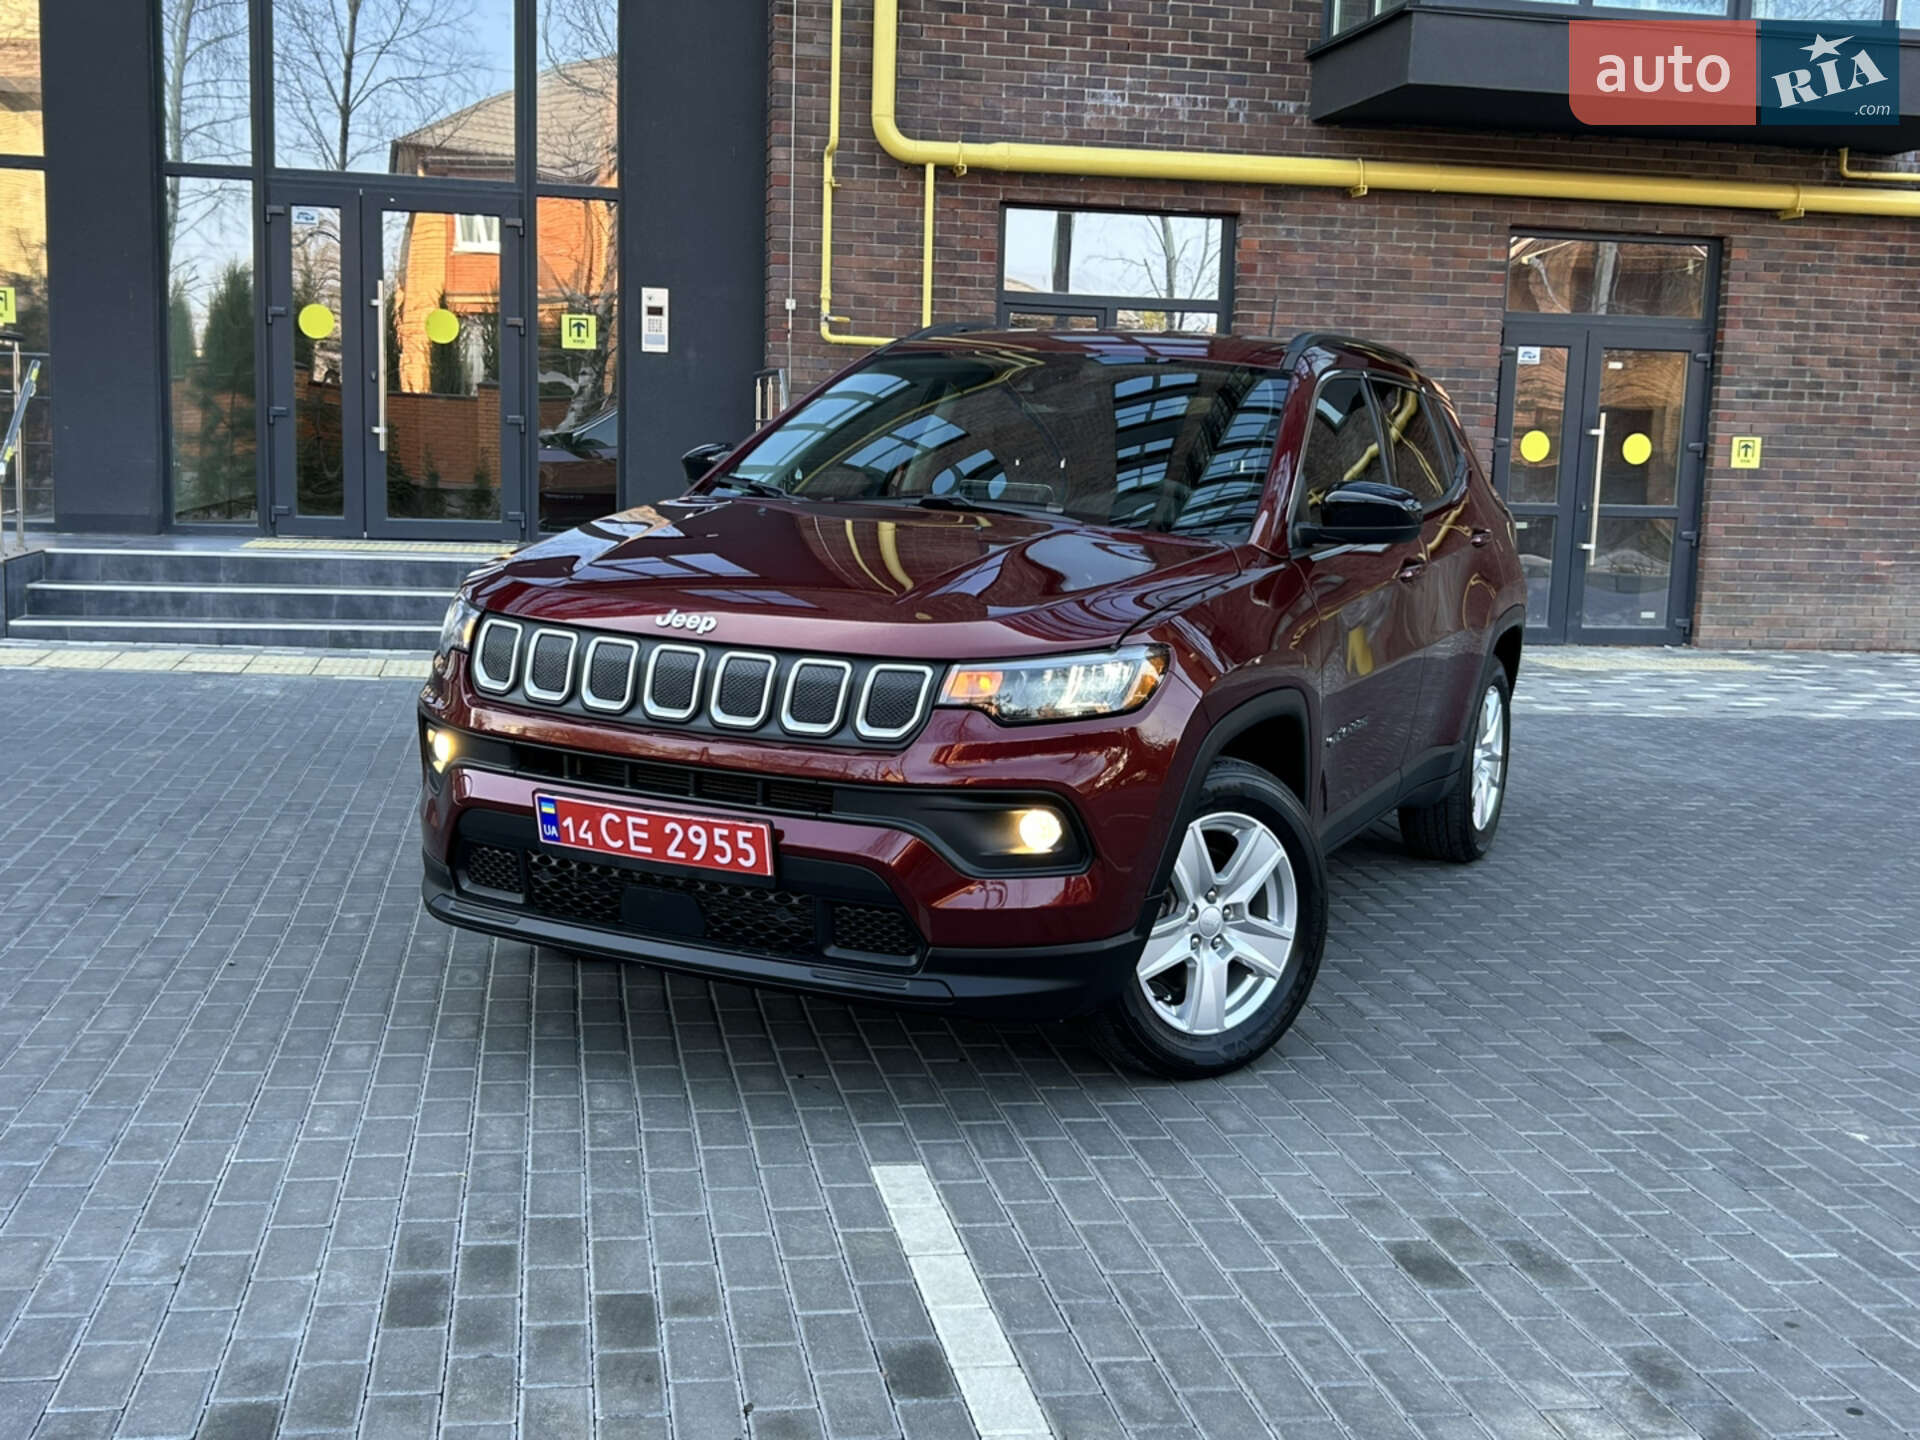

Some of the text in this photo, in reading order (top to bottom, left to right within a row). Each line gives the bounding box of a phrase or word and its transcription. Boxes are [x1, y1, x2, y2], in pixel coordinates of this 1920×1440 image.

[656, 608, 717, 634] Jeep
[543, 823, 559, 838] UA
[562, 812, 757, 868] 14 CE 2955
